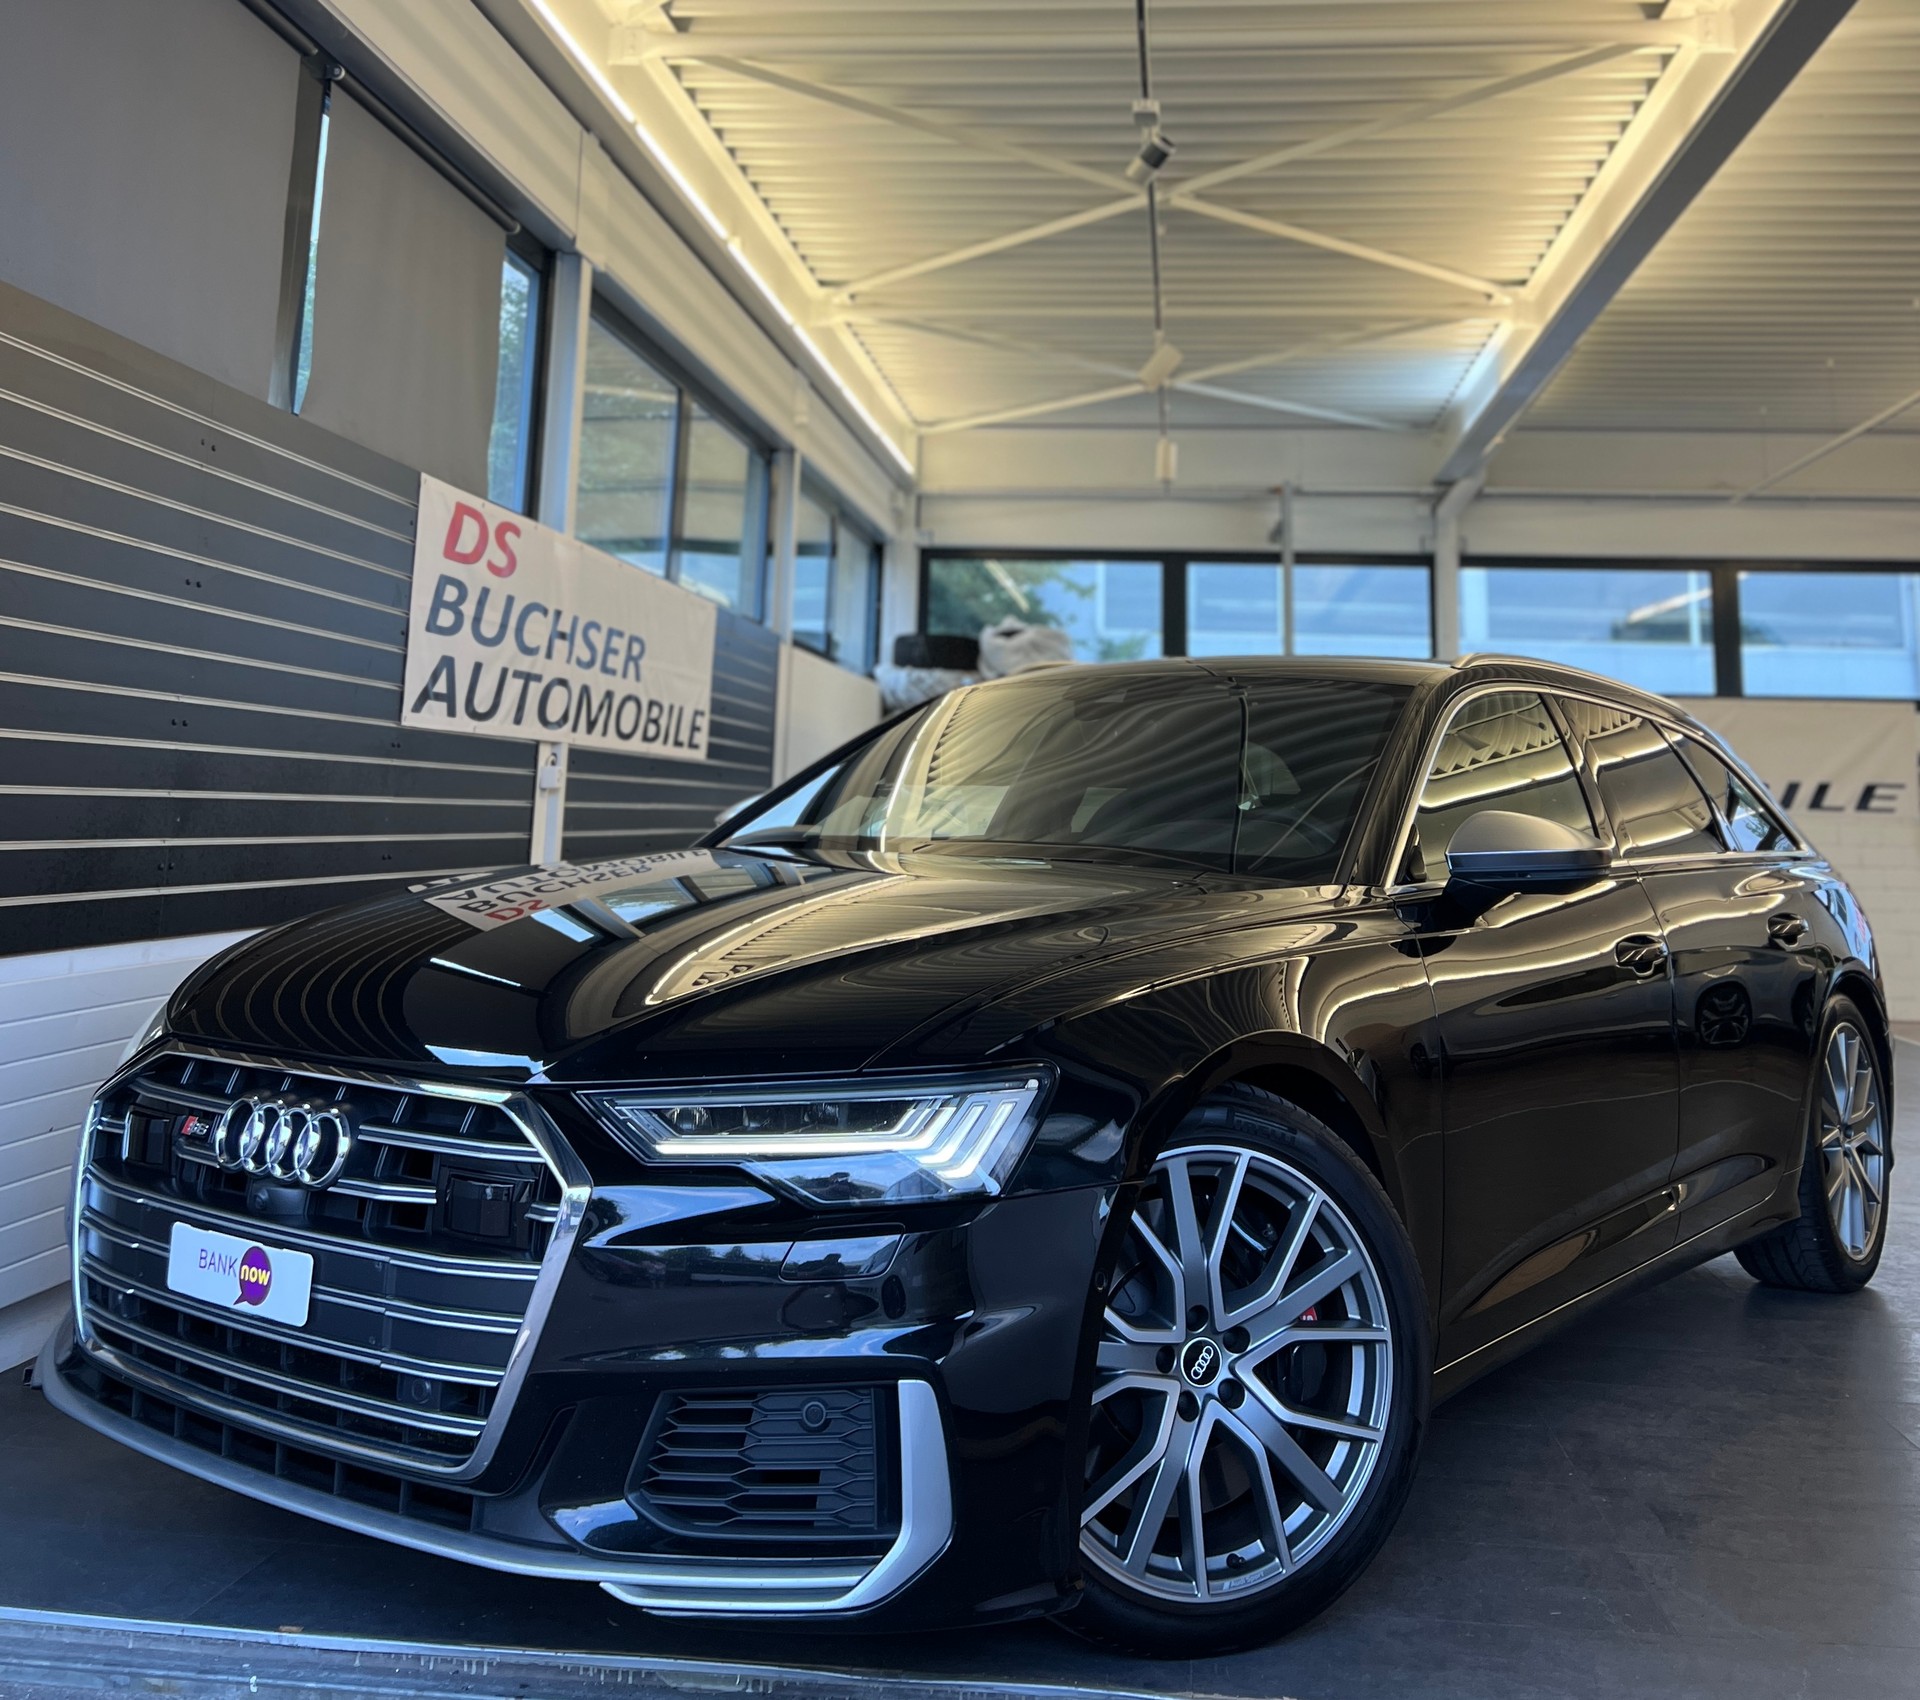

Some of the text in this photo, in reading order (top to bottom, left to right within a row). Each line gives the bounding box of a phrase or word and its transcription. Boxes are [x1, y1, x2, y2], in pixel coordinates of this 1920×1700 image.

[443, 501, 521, 578] DS
[425, 573, 646, 682] BUCHSER
[411, 654, 705, 750] AUTOMOBILE
[1764, 780, 1906, 813] ILE
[198, 1248, 271, 1286] BANK now
